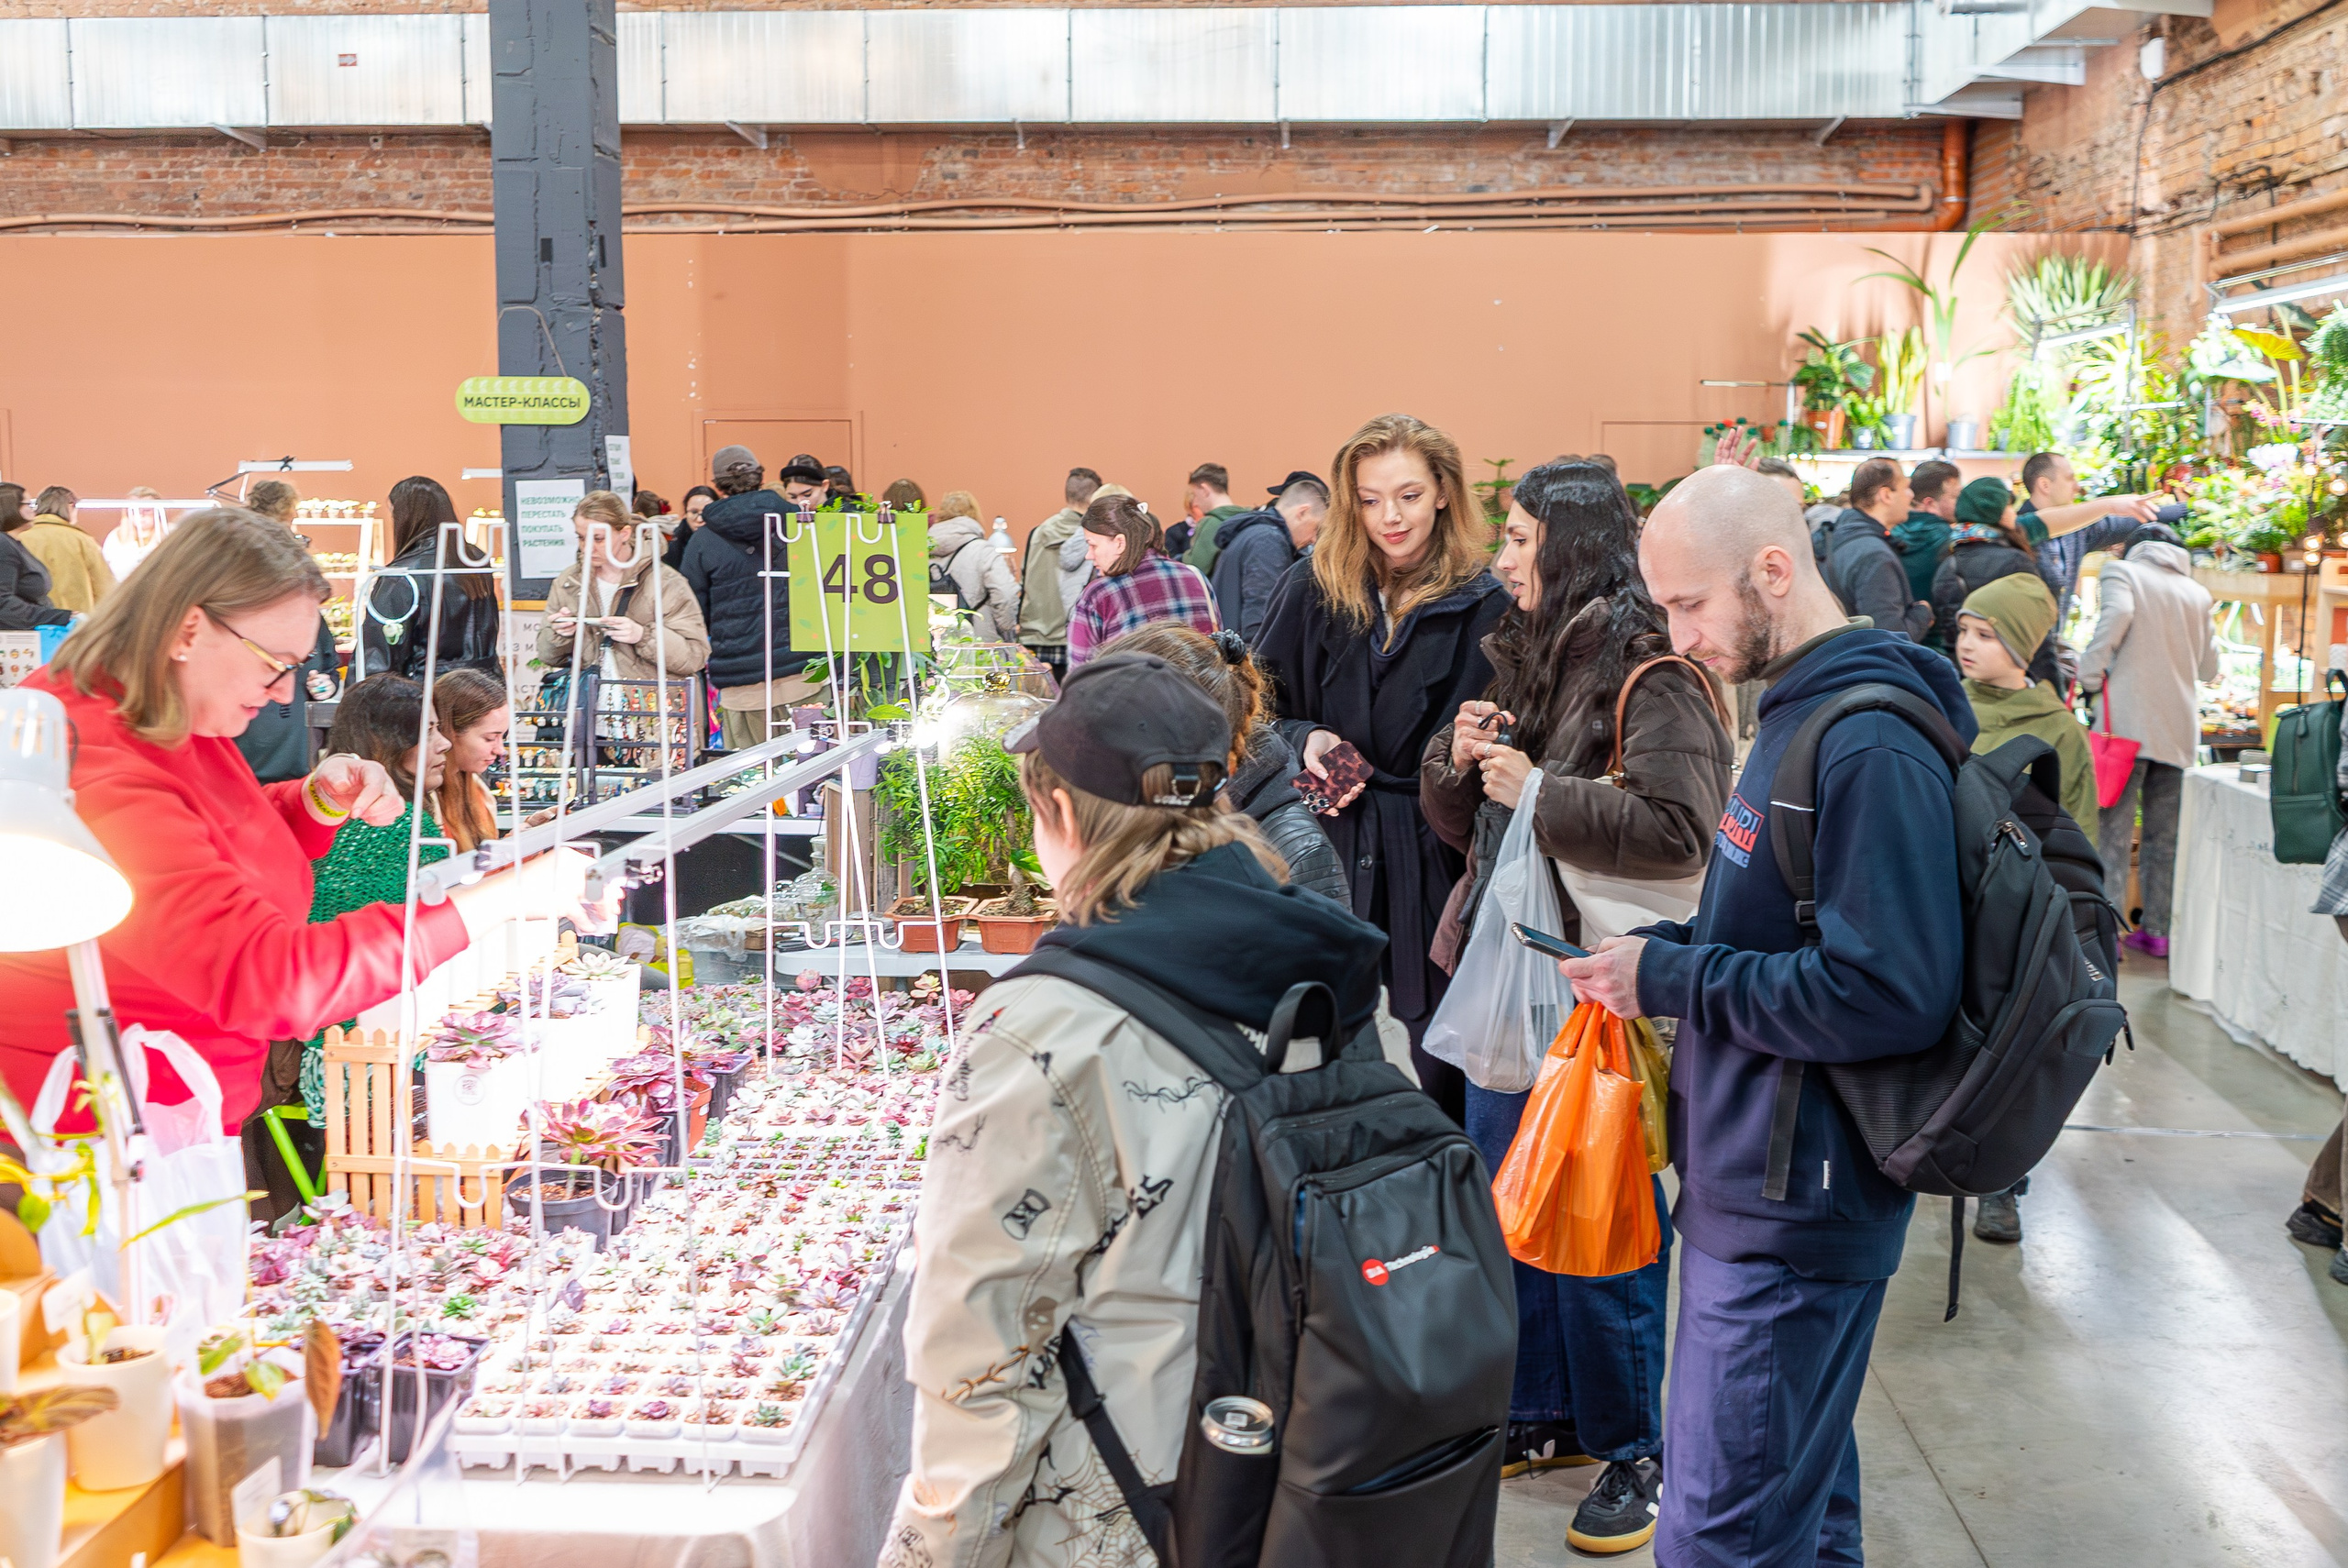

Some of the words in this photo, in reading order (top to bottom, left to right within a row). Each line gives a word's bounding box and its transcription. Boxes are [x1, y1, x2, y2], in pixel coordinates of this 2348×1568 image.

[464, 396, 581, 408] МАСТЕР-КЛАССЫ
[521, 510, 567, 519] ПЕРЕСТАТЬ
[521, 525, 564, 533] ПОКУПАТЬ
[522, 538, 566, 547] РАСТЕНИЯ
[823, 554, 899, 604] 48
